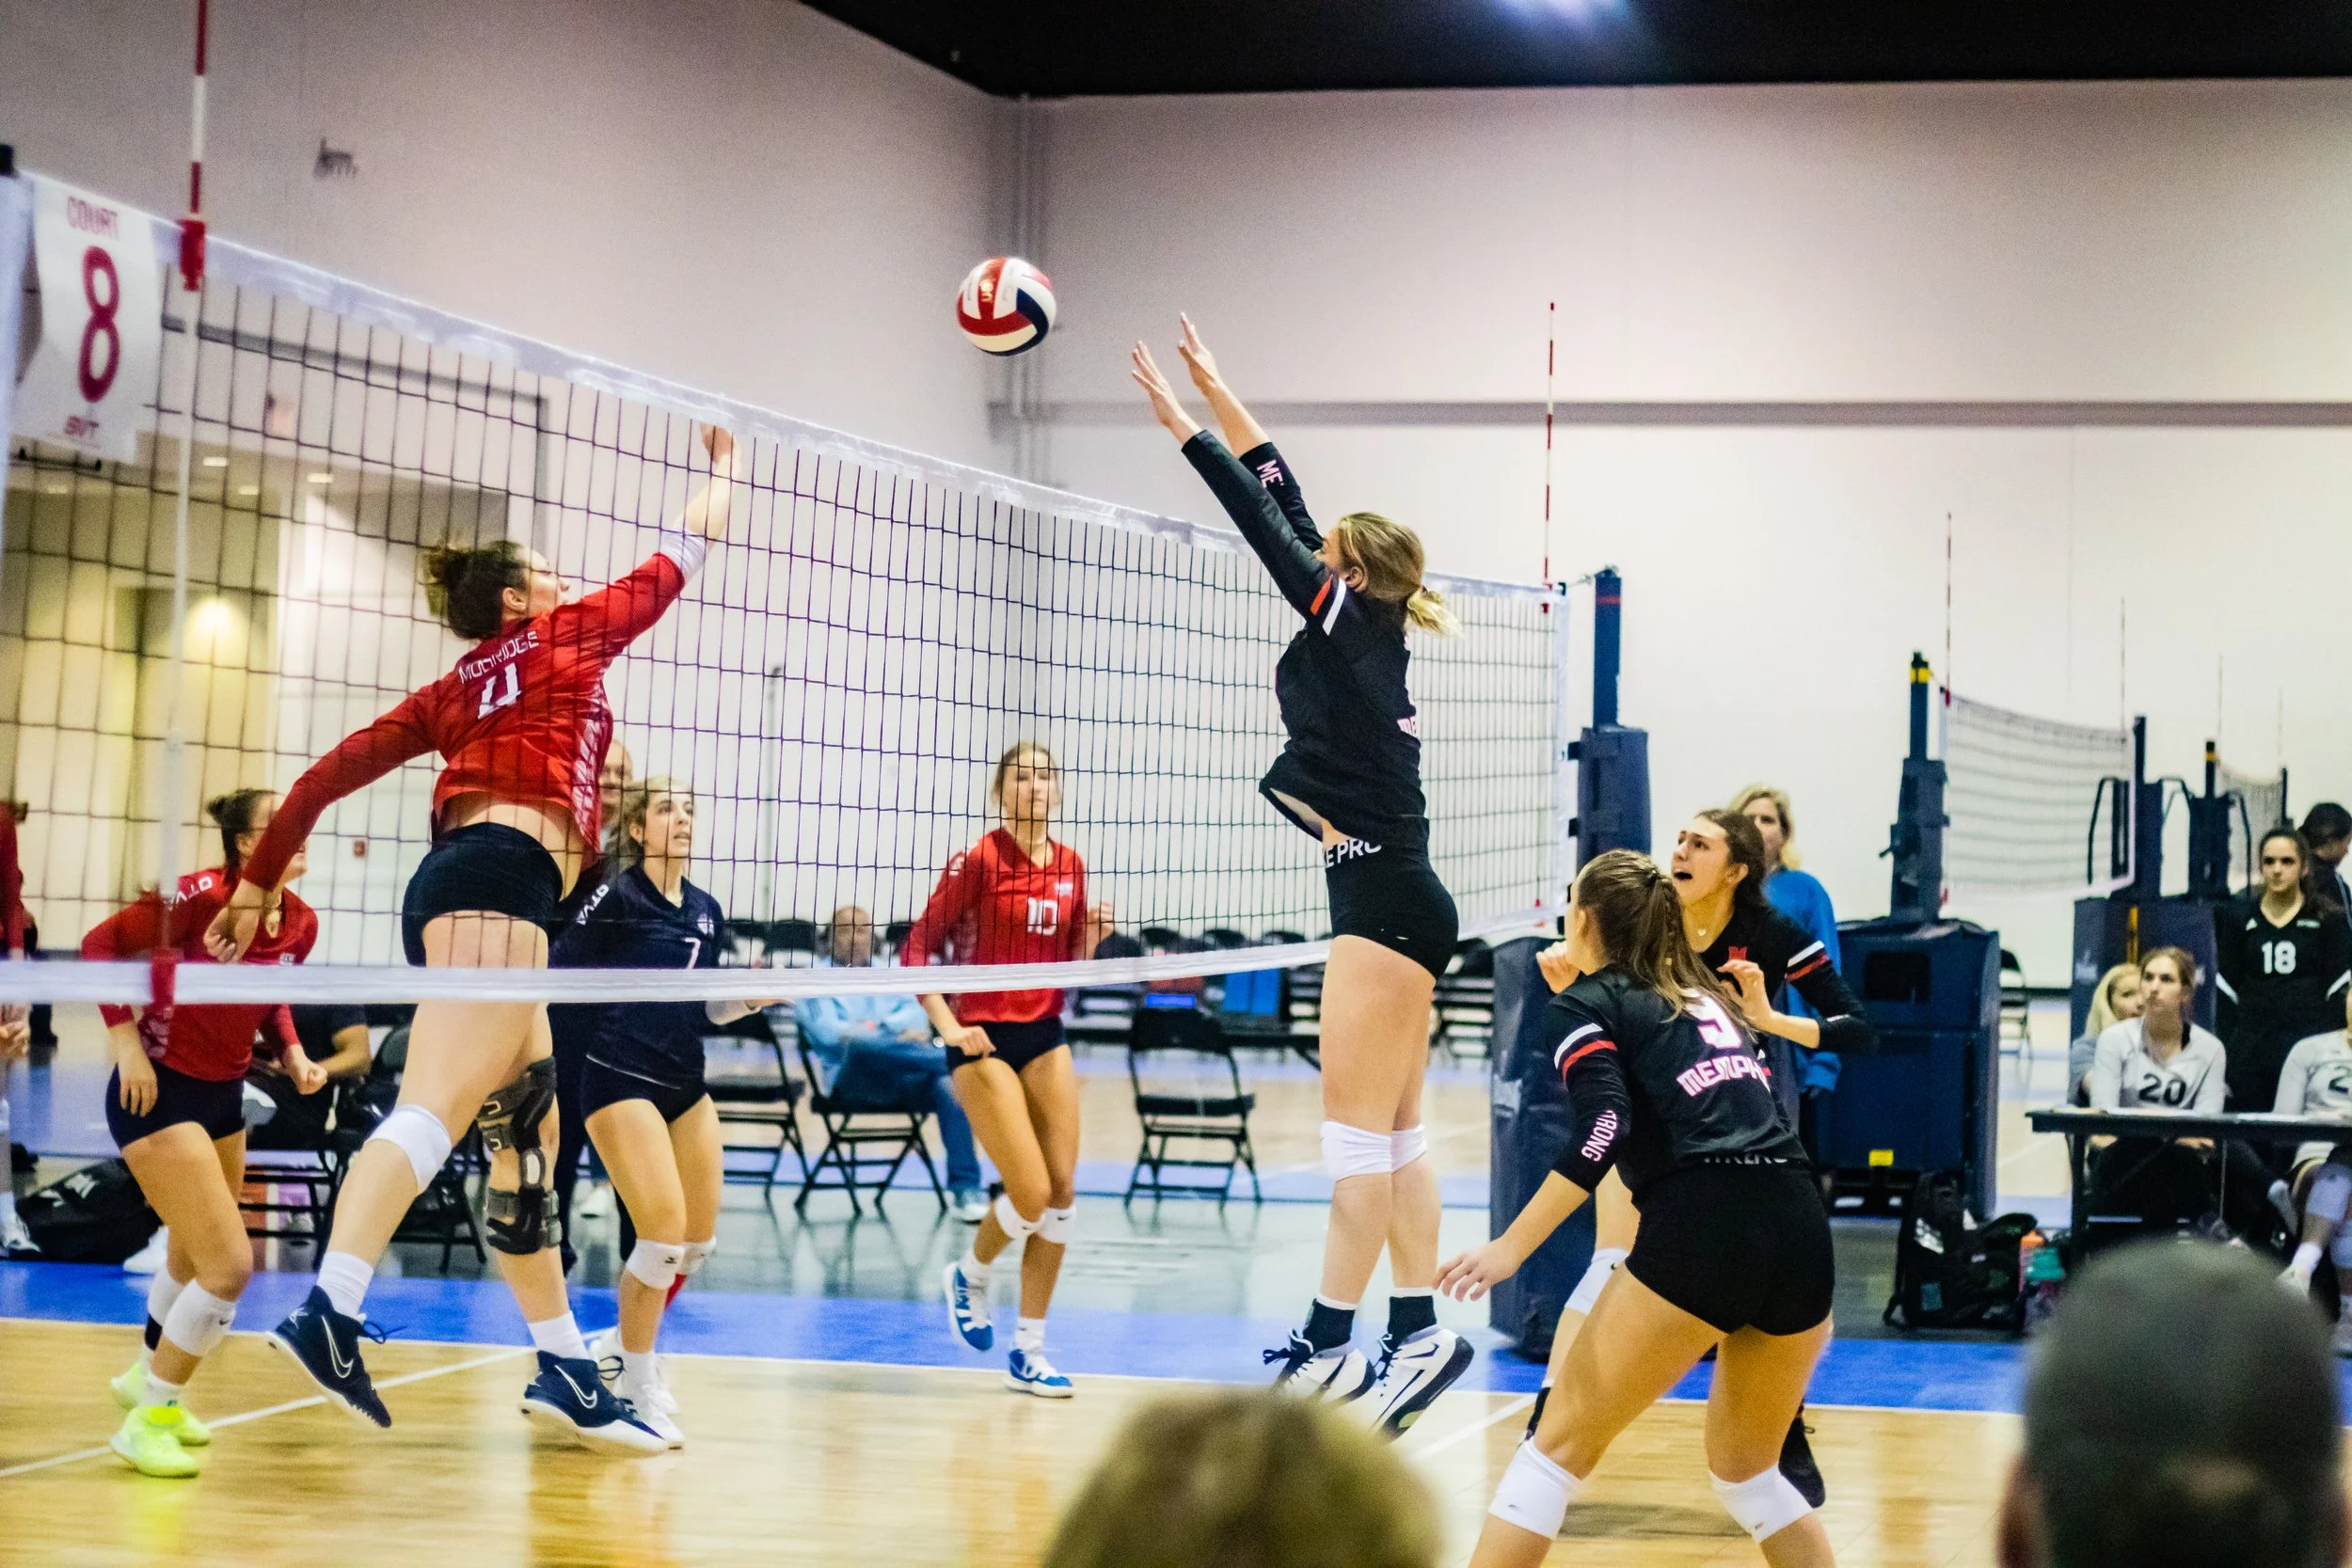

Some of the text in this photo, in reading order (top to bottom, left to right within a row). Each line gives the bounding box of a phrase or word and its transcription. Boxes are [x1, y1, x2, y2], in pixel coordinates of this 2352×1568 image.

[68, 195, 119, 241] COURT
[78, 245, 120, 404] 8
[1256, 459, 1284, 488] ME
[1026, 896, 1059, 936] 10
[682, 937, 701, 970] 7
[2261, 941, 2297, 974] 18
[2138, 1073, 2186, 1105] 20
[1581, 1109, 1617, 1162] TRONG
